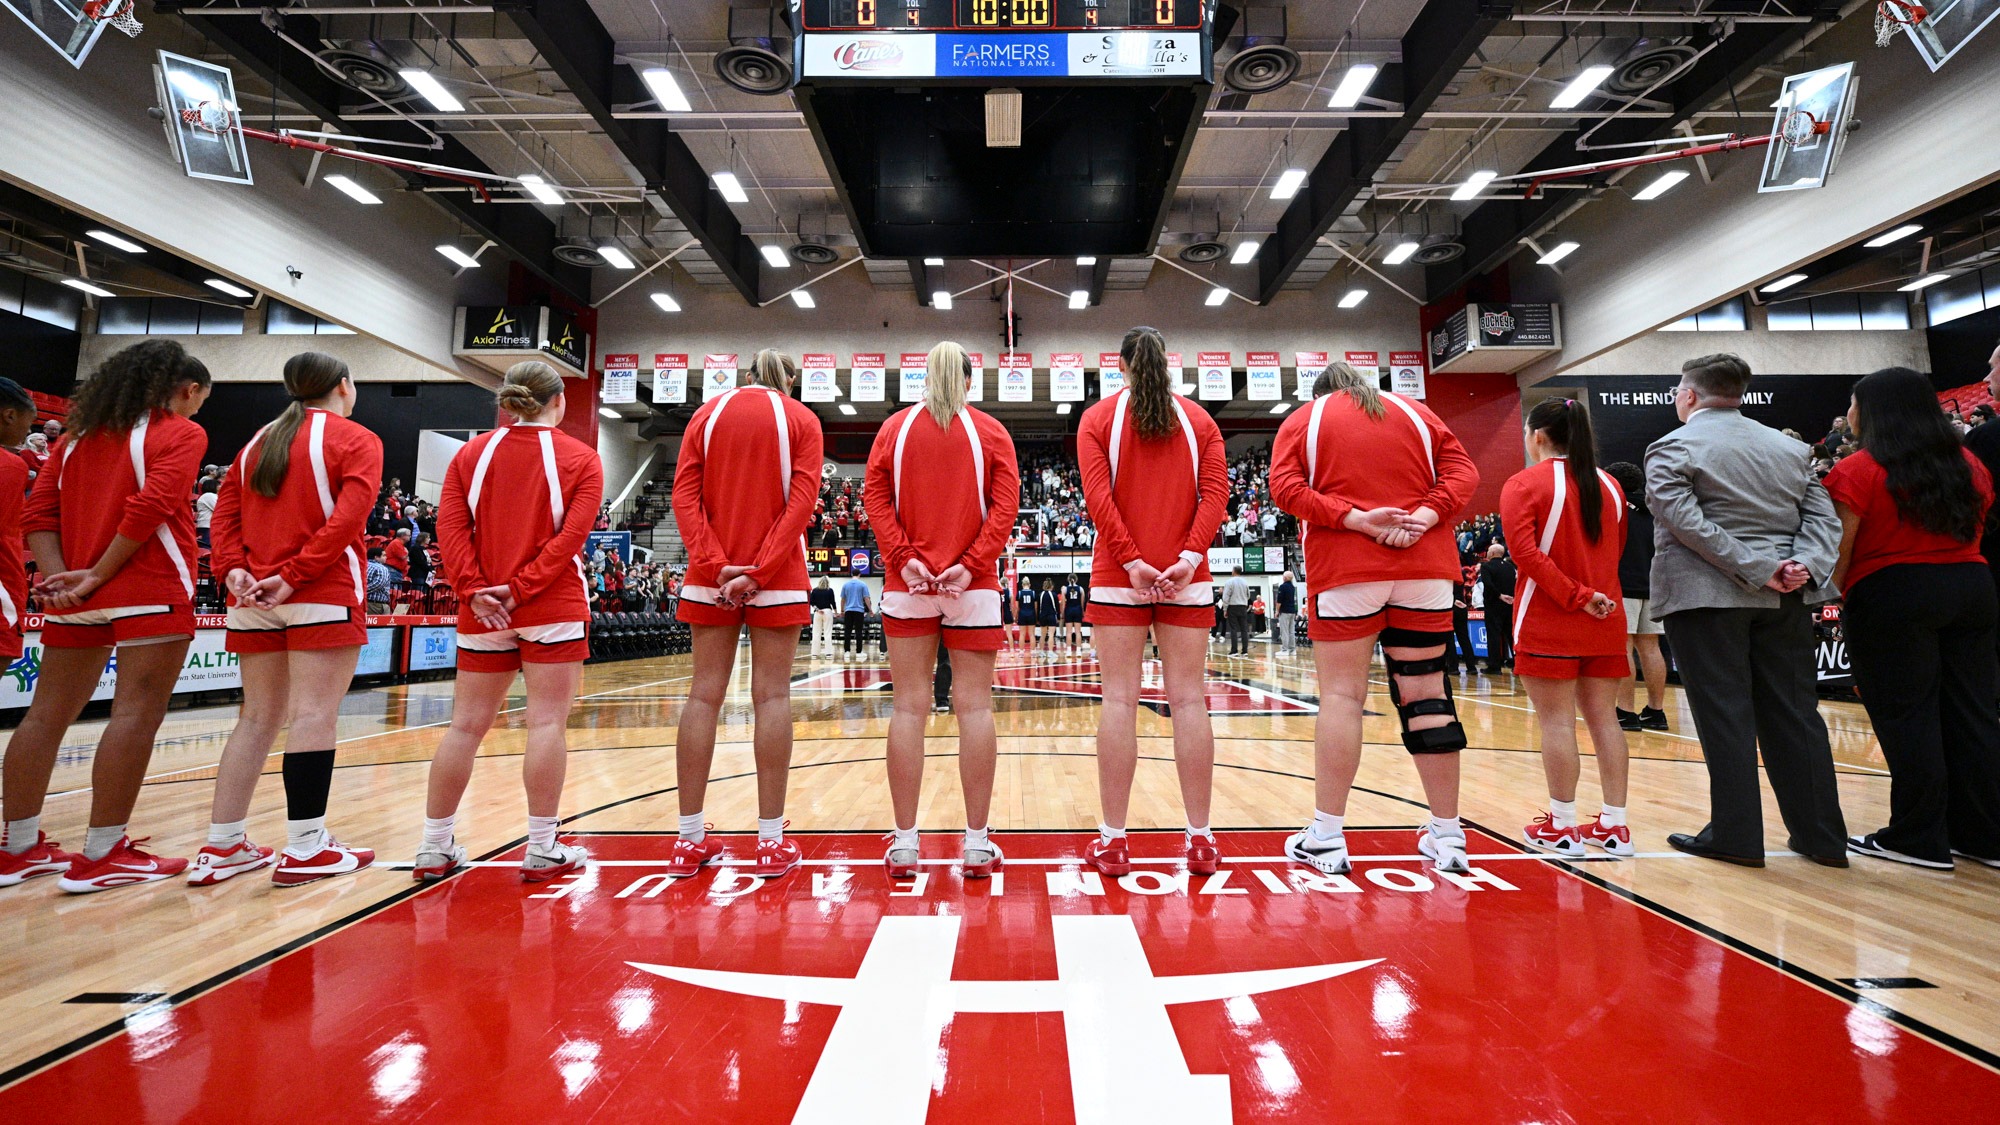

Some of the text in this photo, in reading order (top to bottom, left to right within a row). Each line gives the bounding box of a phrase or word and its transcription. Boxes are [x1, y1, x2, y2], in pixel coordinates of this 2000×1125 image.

[857, 0, 875, 25] 0
[908, 10, 919, 26] 4
[972, 0, 1048, 25] 10:00
[1086, 9, 1097, 25] 4
[1155, 0, 1174, 25] 0
[953, 44, 1050, 60] FARMERS
[1480, 314, 1515, 330] BUCKEYE
[472, 335, 530, 345] AxioFitness
[551, 342, 582, 366] AxioFitness
[1251, 371, 1274, 379] NCAA
[1599, 392, 1630, 405] THE
[1741, 392, 1774, 405] MILY
[1224, 557, 1241, 565] RITE
[1022, 595, 1031, 604] 10
[1069, 591, 1078, 599] 12
[187, 651, 239, 669] ALTH
[207, 671, 238, 680] University
